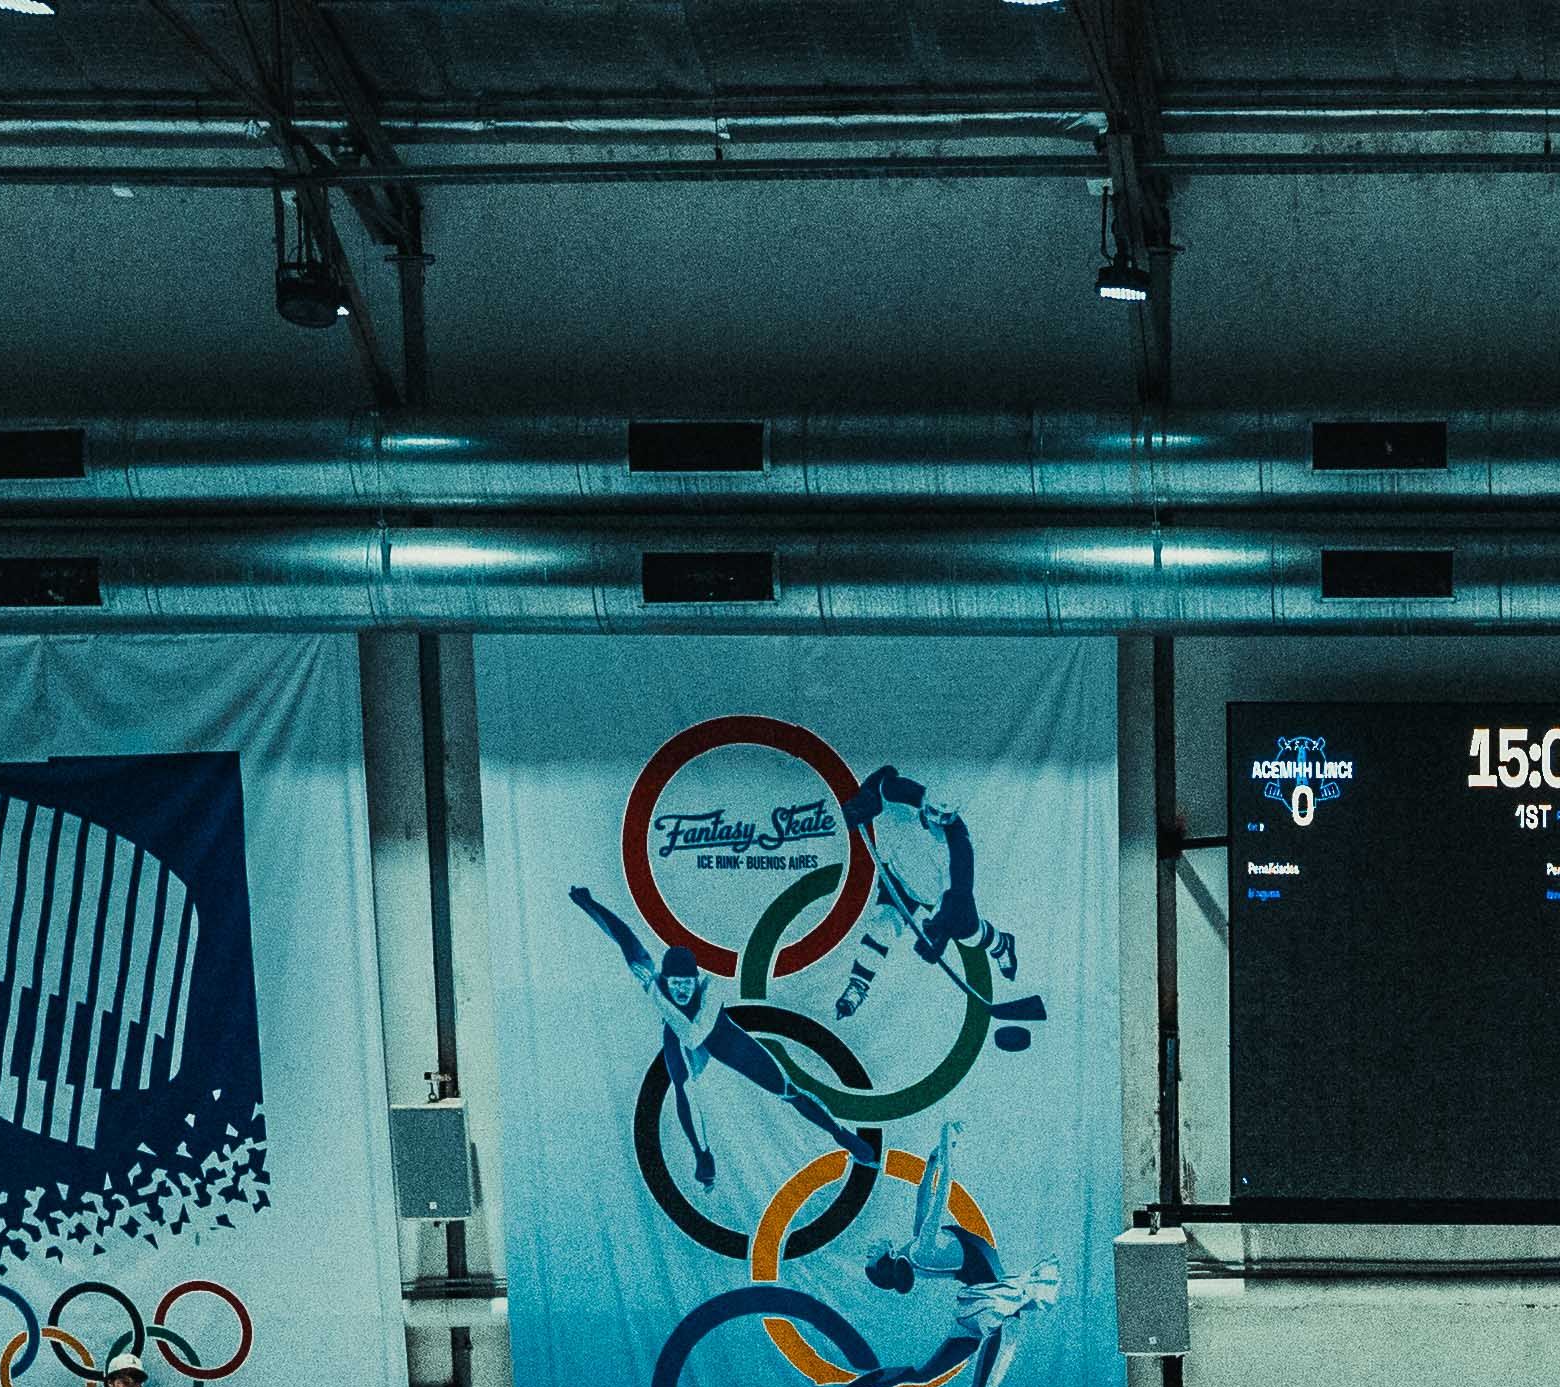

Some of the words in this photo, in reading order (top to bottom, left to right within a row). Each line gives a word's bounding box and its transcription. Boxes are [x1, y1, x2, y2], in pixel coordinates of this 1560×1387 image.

[1292, 785, 1314, 826] 0
[1515, 804, 1552, 829] 1ST
[654, 809, 757, 857] Fantasy
[758, 800, 837, 850] Skate
[697, 855, 713, 869] ICE
[746, 855, 787, 870] BUENOS
[788, 854, 818, 870] AIRES
